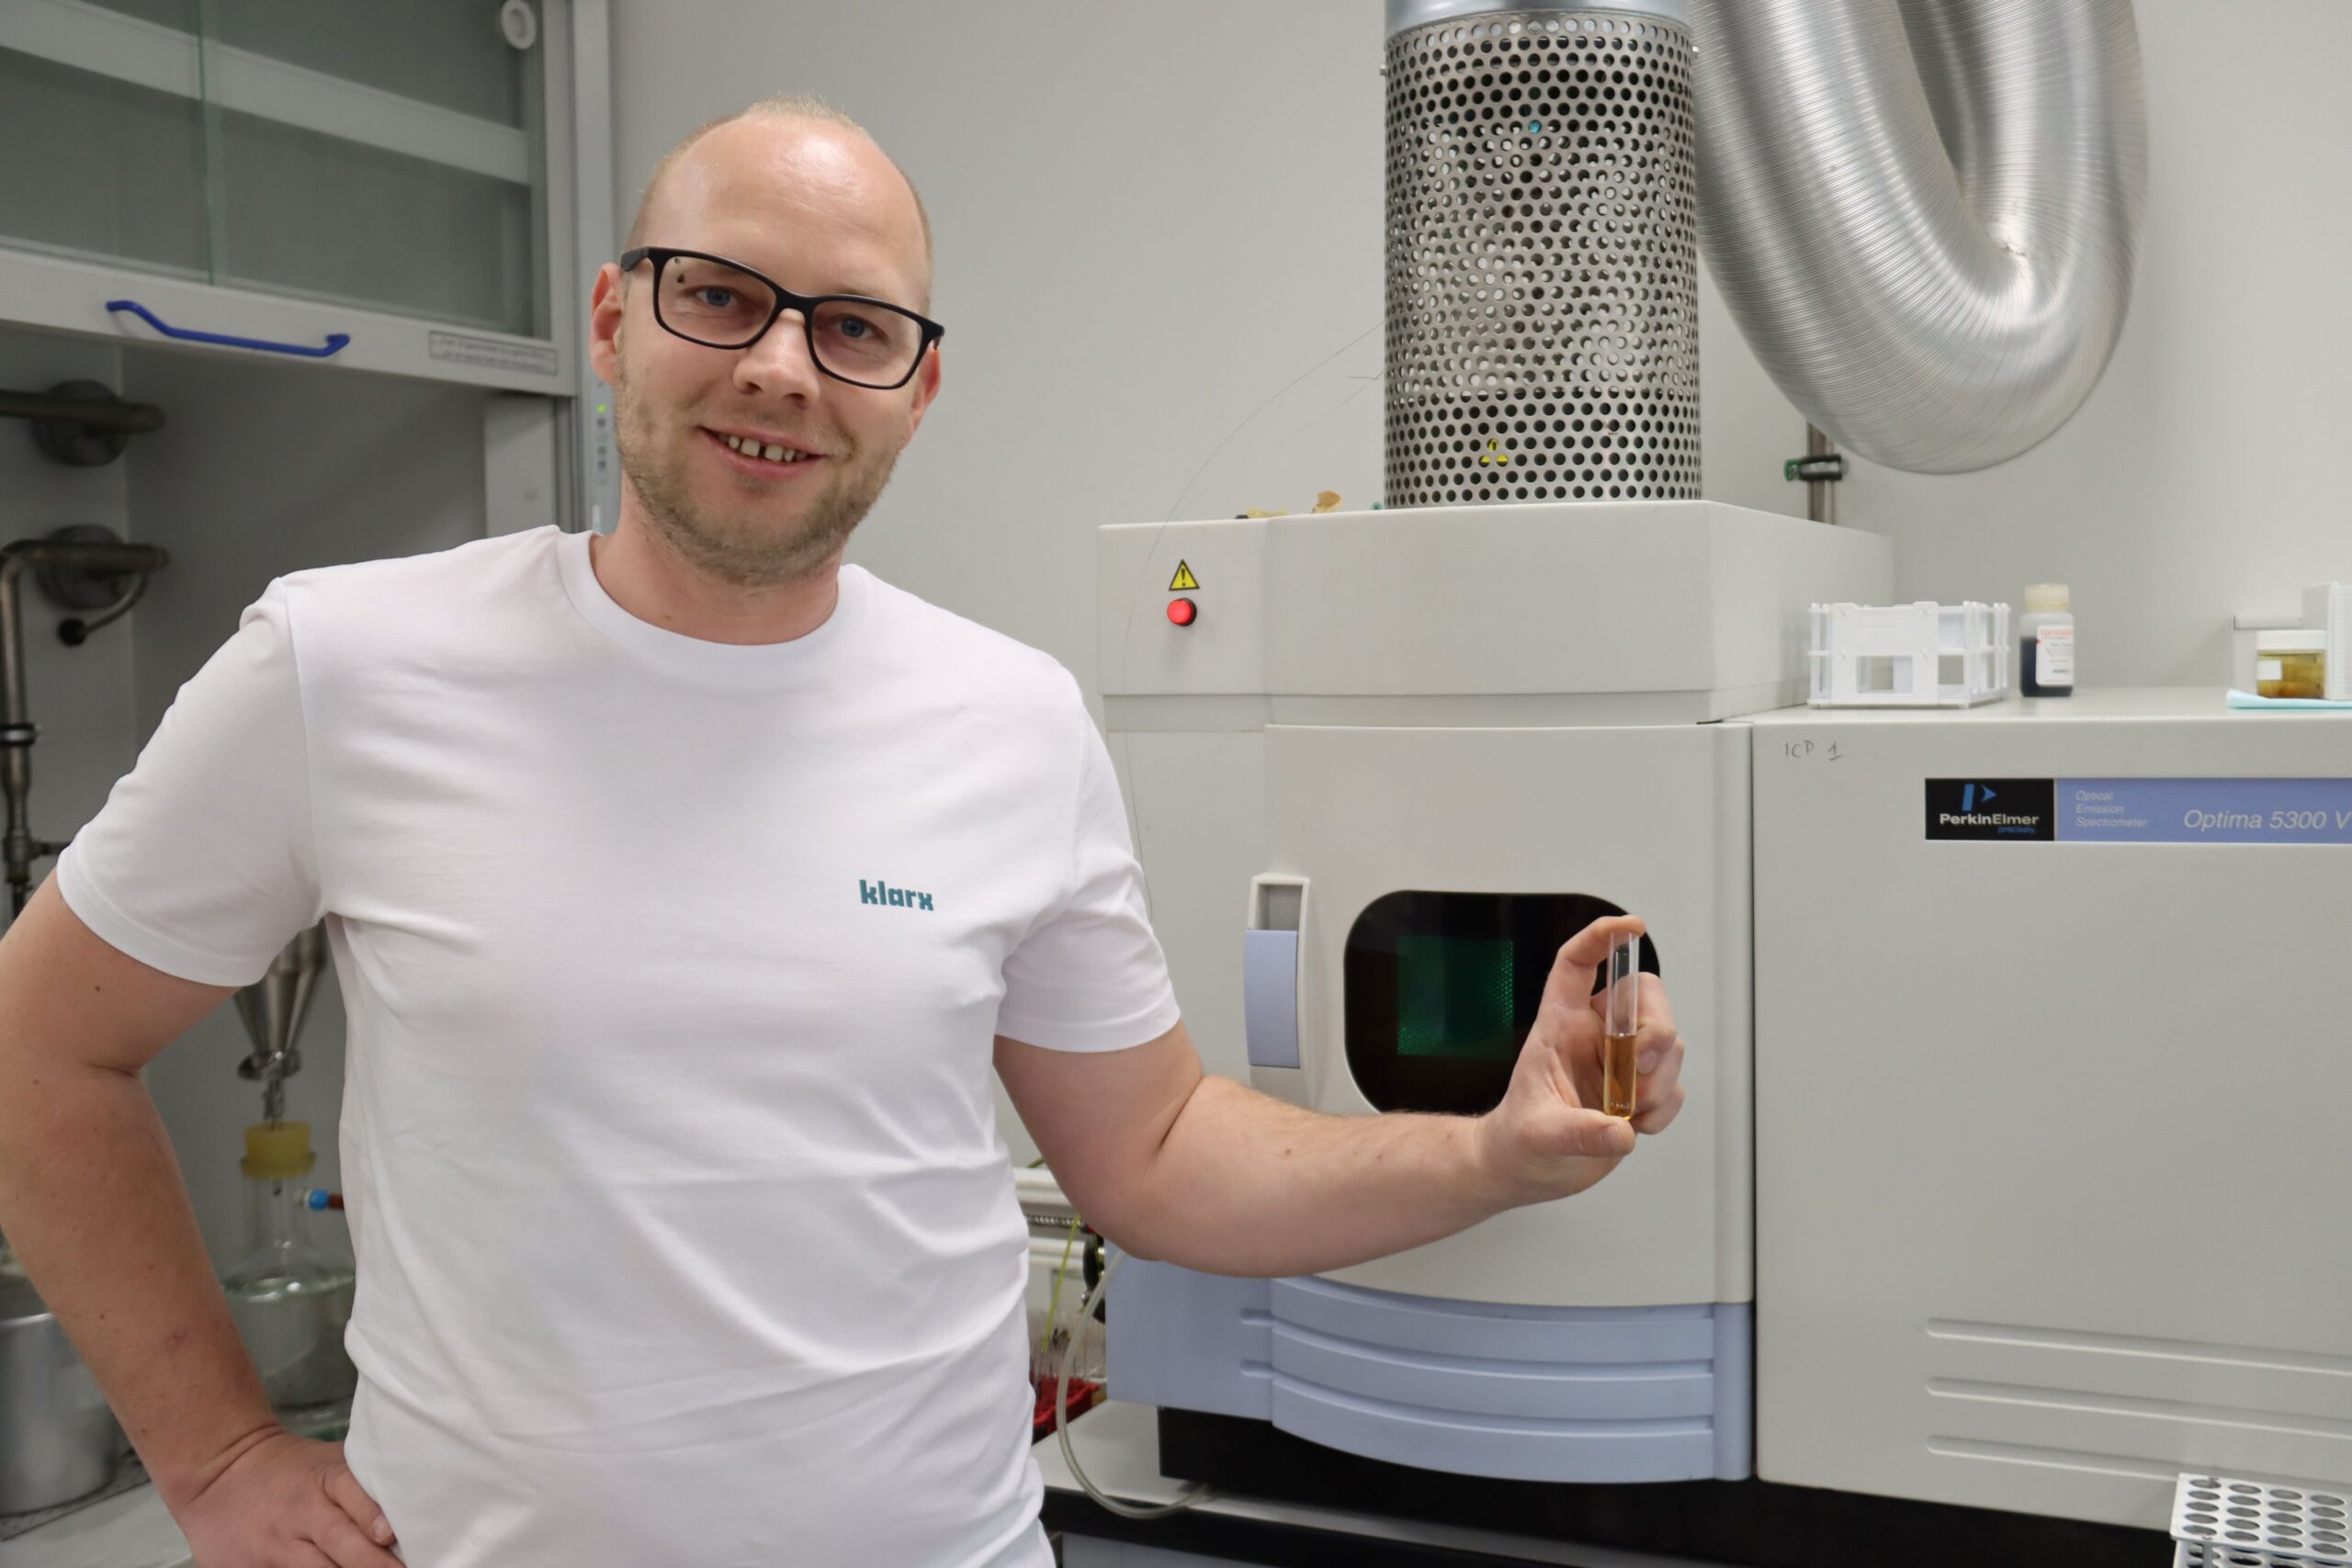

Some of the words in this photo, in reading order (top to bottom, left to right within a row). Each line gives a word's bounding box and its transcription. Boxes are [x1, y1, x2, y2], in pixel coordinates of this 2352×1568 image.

[1785, 739, 1815, 757] ICP
[1827, 740, 1842, 761] 1
[2075, 790, 2113, 802] Optical
[2075, 804, 2124, 814] Emission
[1939, 813, 2039, 825] PerkinElmer
[2184, 808, 2262, 832] Optima
[2269, 810, 2327, 829] 5300
[859, 879, 933, 911] klarx
